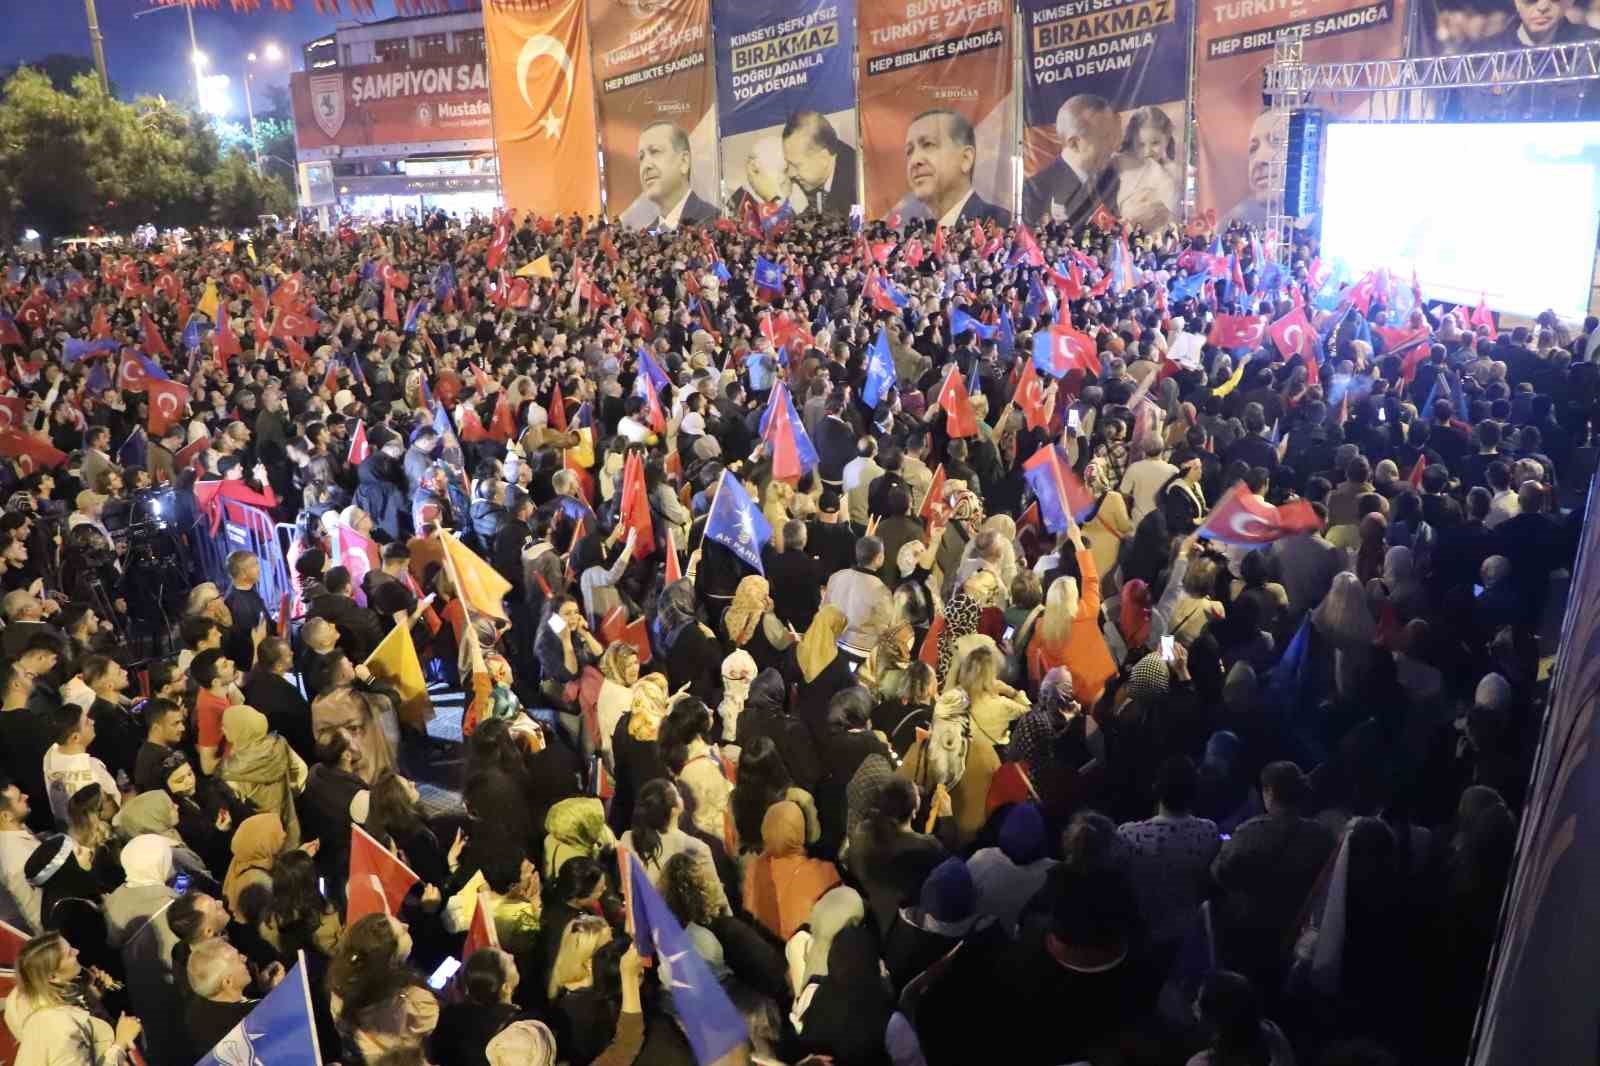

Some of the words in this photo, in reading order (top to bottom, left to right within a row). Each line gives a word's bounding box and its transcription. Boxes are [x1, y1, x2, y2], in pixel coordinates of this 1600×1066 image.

[1039, 2, 1169, 47] BIRAKMAZ
[1211, 39, 1239, 56] HEP
[1314, 6, 1387, 34] SANDIĞA
[736, 26, 834, 68] BIRAKMAZ
[870, 58, 894, 73] HEP
[948, 30, 1003, 54] SANDIĞA
[1034, 47, 1084, 70] DOĞRU
[1088, 32, 1153, 58] ADAMLA
[351, 64, 452, 107] ŞAMPİYON
[605, 77, 624, 92] HEP
[732, 67, 772, 87] DOĞRU
[774, 53, 824, 75] ADAMLA
[733, 83, 764, 100] YOLA
[765, 72, 807, 92] DEVAM
[1035, 66, 1073, 85] YOLA
[1076, 54, 1131, 78] DEVAM
[438, 99, 490, 118] Mustafa
